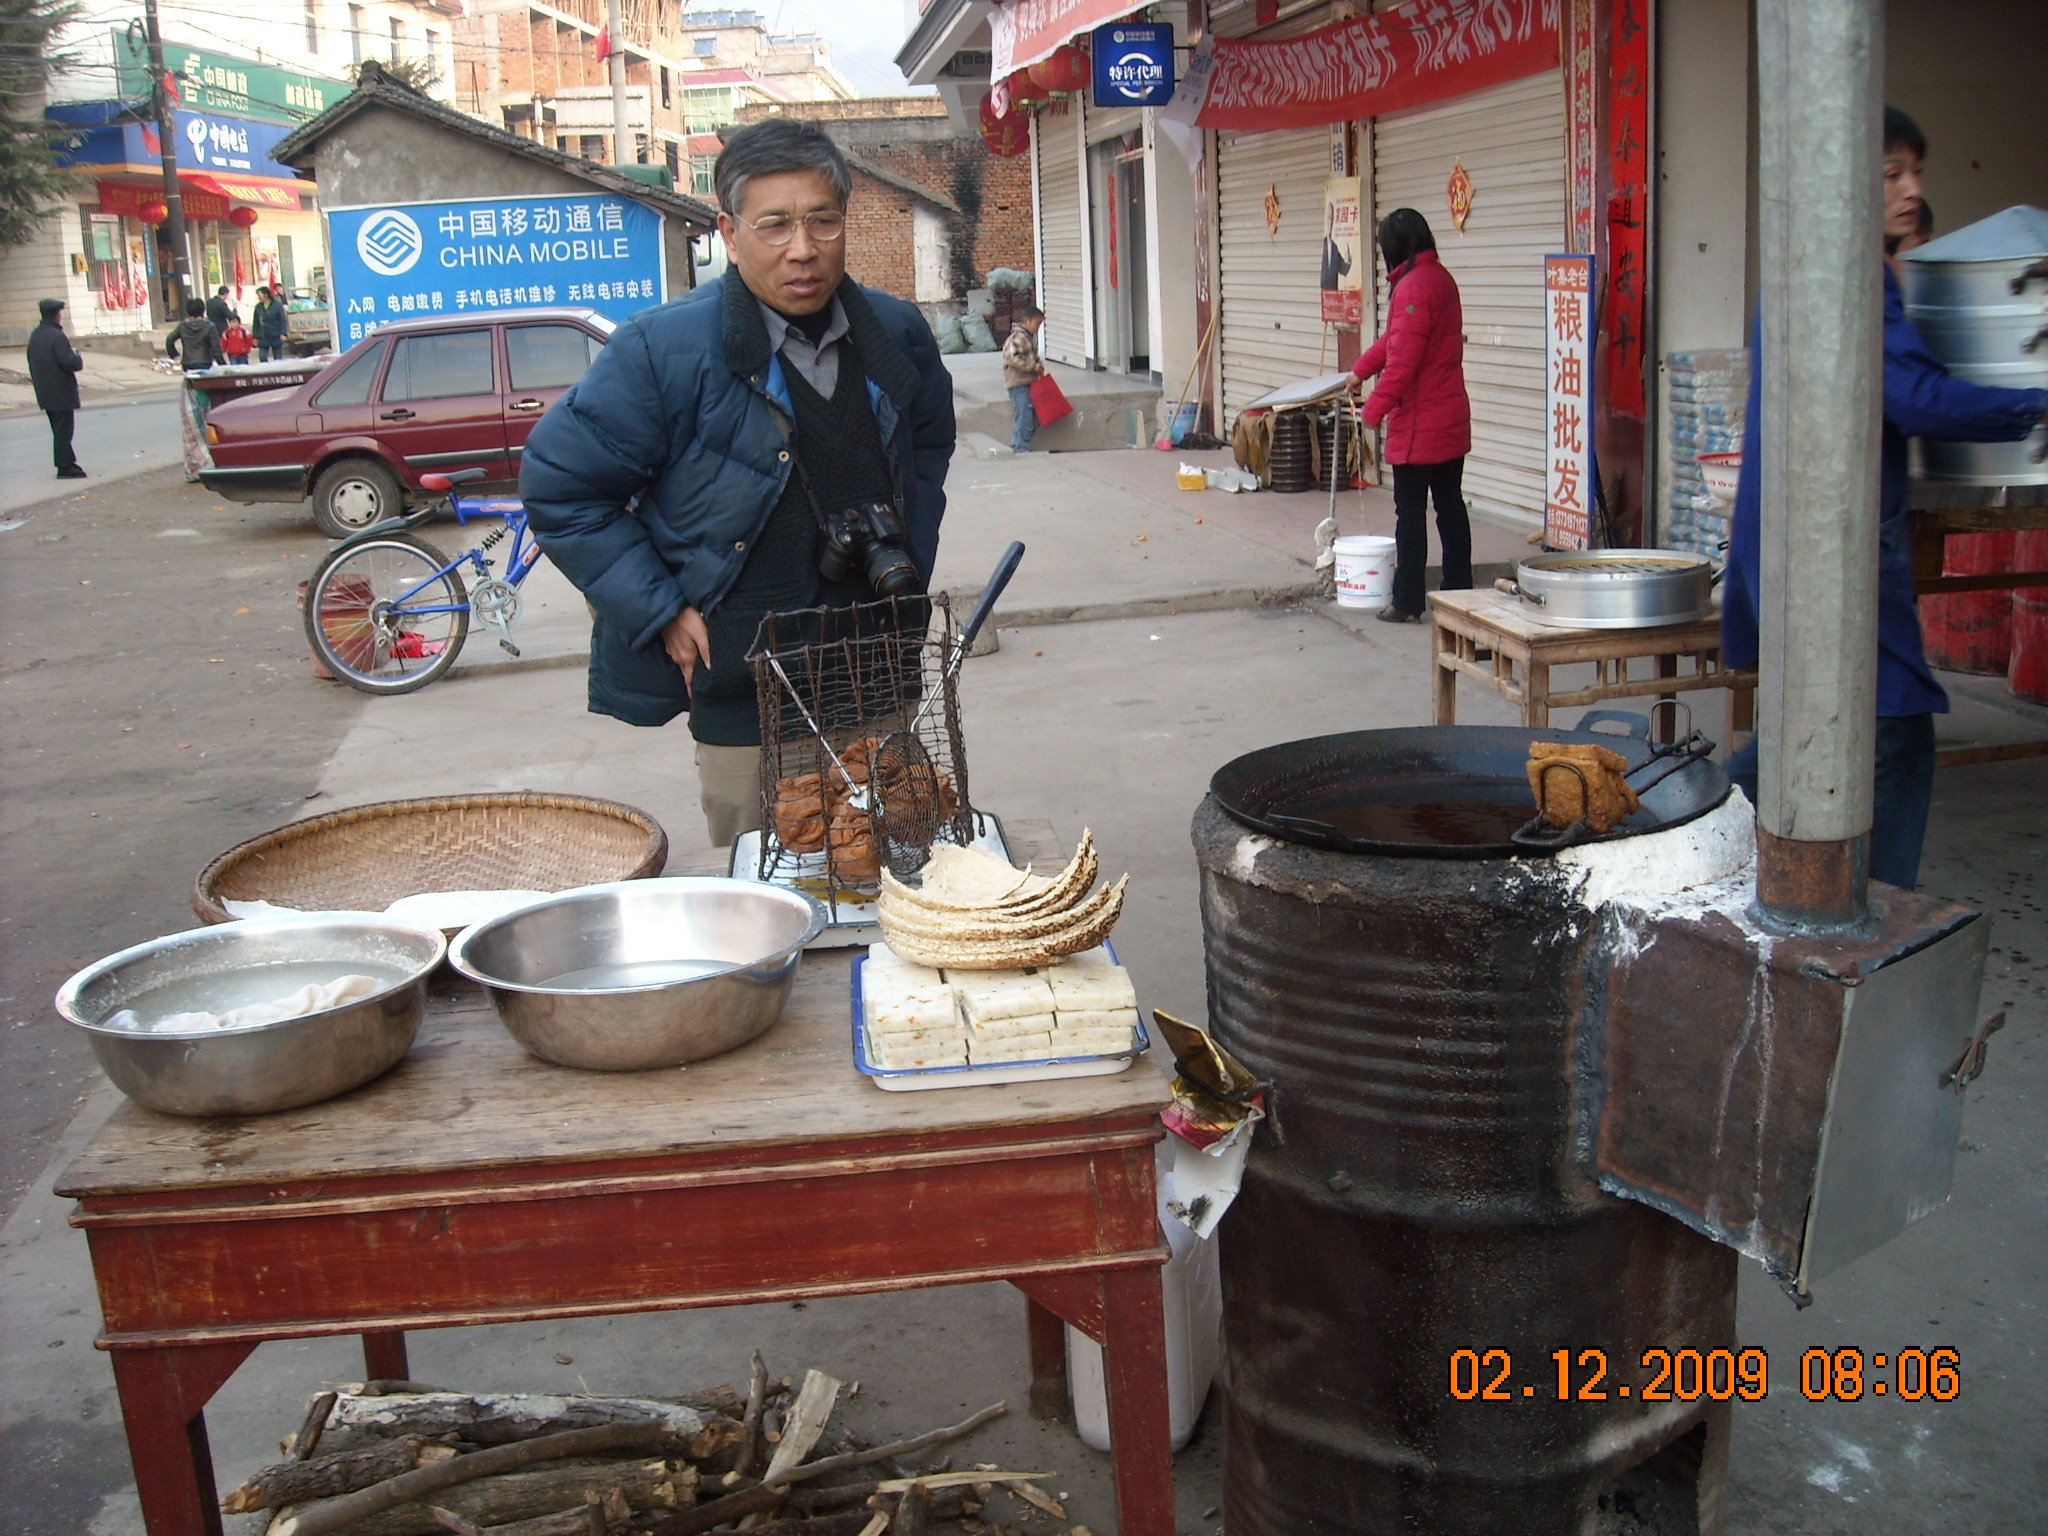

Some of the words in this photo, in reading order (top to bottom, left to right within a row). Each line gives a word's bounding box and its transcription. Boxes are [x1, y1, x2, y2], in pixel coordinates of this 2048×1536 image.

[203, 65, 248, 95] 中国邮政
[1109, 64, 1163, 81] 特许代理
[209, 122, 248, 154] 中国电信
[438, 202, 624, 240] 中国移动通信
[440, 243, 523, 268] CHINA
[530, 237, 630, 264] MOBILE
[347, 296, 375, 314] 入网
[456, 285, 556, 309] 手机电话机维修
[568, 279, 654, 300] 无线电话安装
[1553, 292, 1582, 509] 粮油批发
